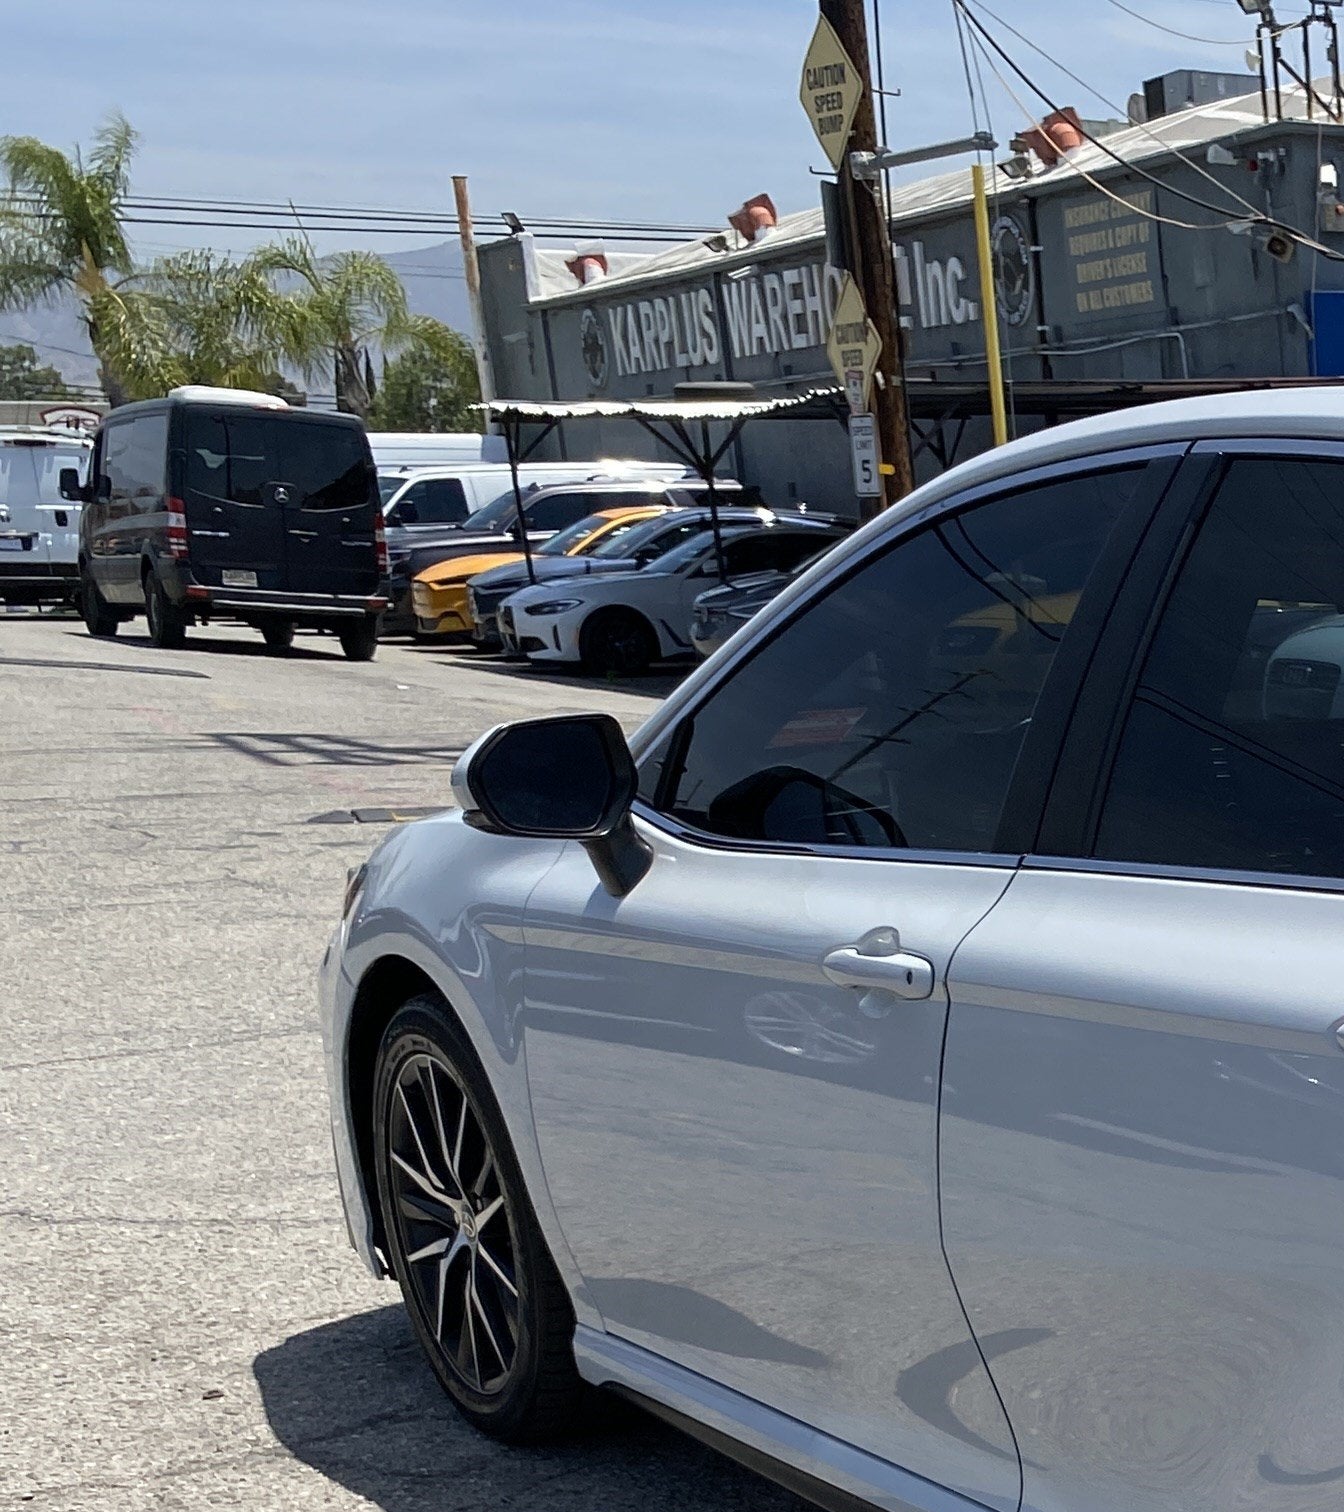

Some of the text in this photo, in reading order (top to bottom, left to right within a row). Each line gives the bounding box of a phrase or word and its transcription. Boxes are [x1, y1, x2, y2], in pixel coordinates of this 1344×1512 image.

[806, 62, 847, 91] CAUTION
[814, 91, 843, 114] SPEED
[818, 114, 844, 136] BUMP
[609, 288, 720, 377] KARPLUS
[912, 240, 979, 329] Inc.
[861, 459, 872, 484] 5
